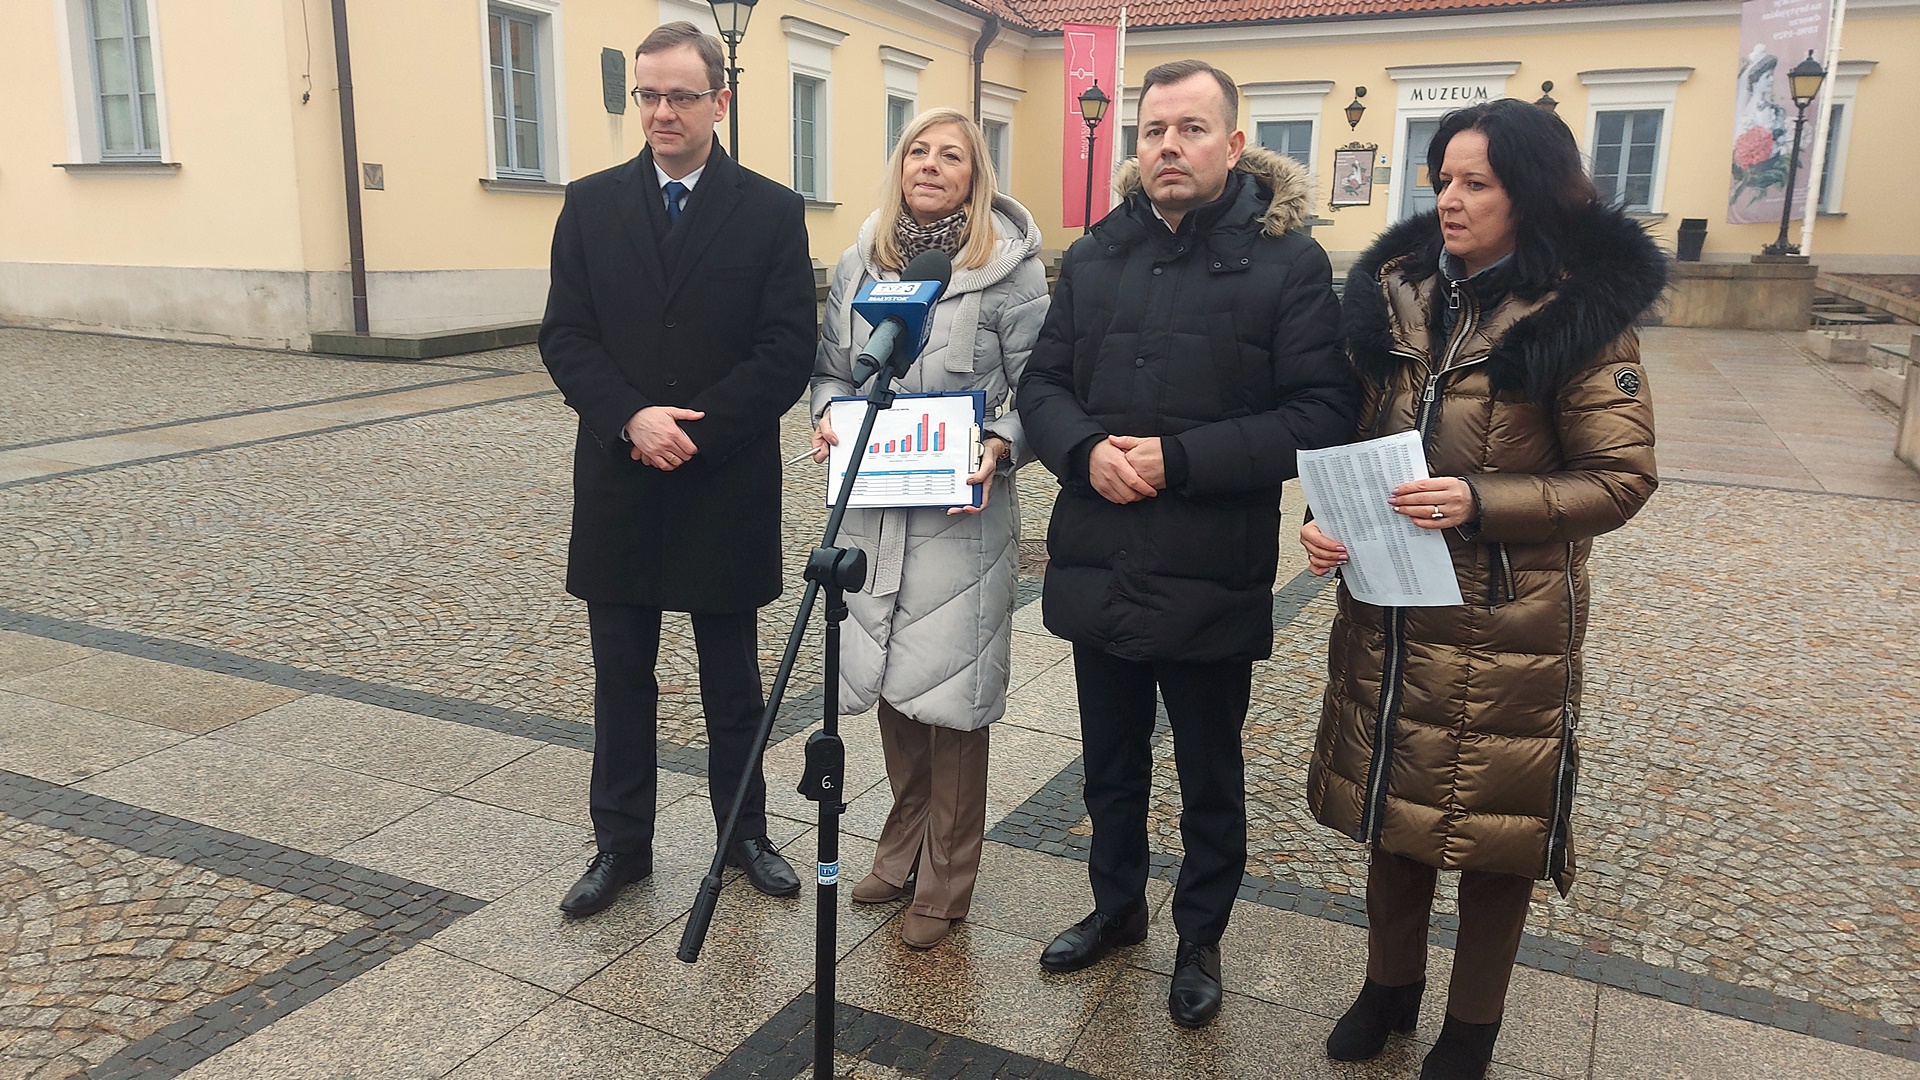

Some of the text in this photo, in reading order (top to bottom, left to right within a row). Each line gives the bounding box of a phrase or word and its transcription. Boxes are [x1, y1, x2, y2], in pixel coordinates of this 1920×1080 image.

[1410, 86, 1488, 101] MUZEUM
[904, 284, 915, 293] 3
[821, 775, 835, 789] 6.
